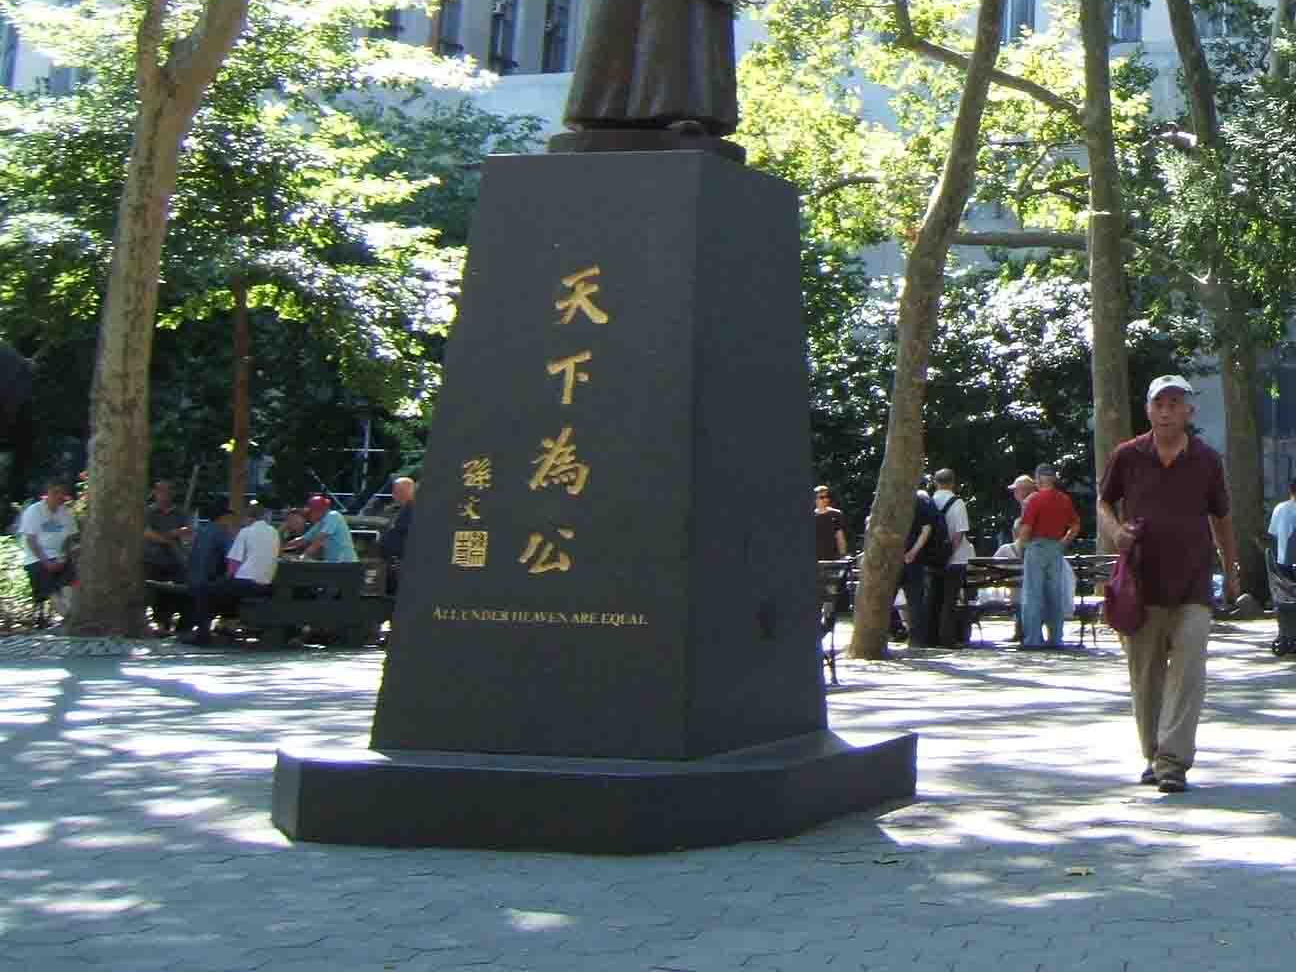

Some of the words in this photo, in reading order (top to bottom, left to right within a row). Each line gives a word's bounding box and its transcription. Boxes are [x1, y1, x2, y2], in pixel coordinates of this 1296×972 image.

[519, 265, 608, 573] 天下為公
[432, 605, 460, 621] ALL
[462, 609, 511, 622] UNDER
[513, 610, 569, 624] HEAVEN
[573, 611, 600, 624] ARE
[601, 612, 648, 626] EQUAL
